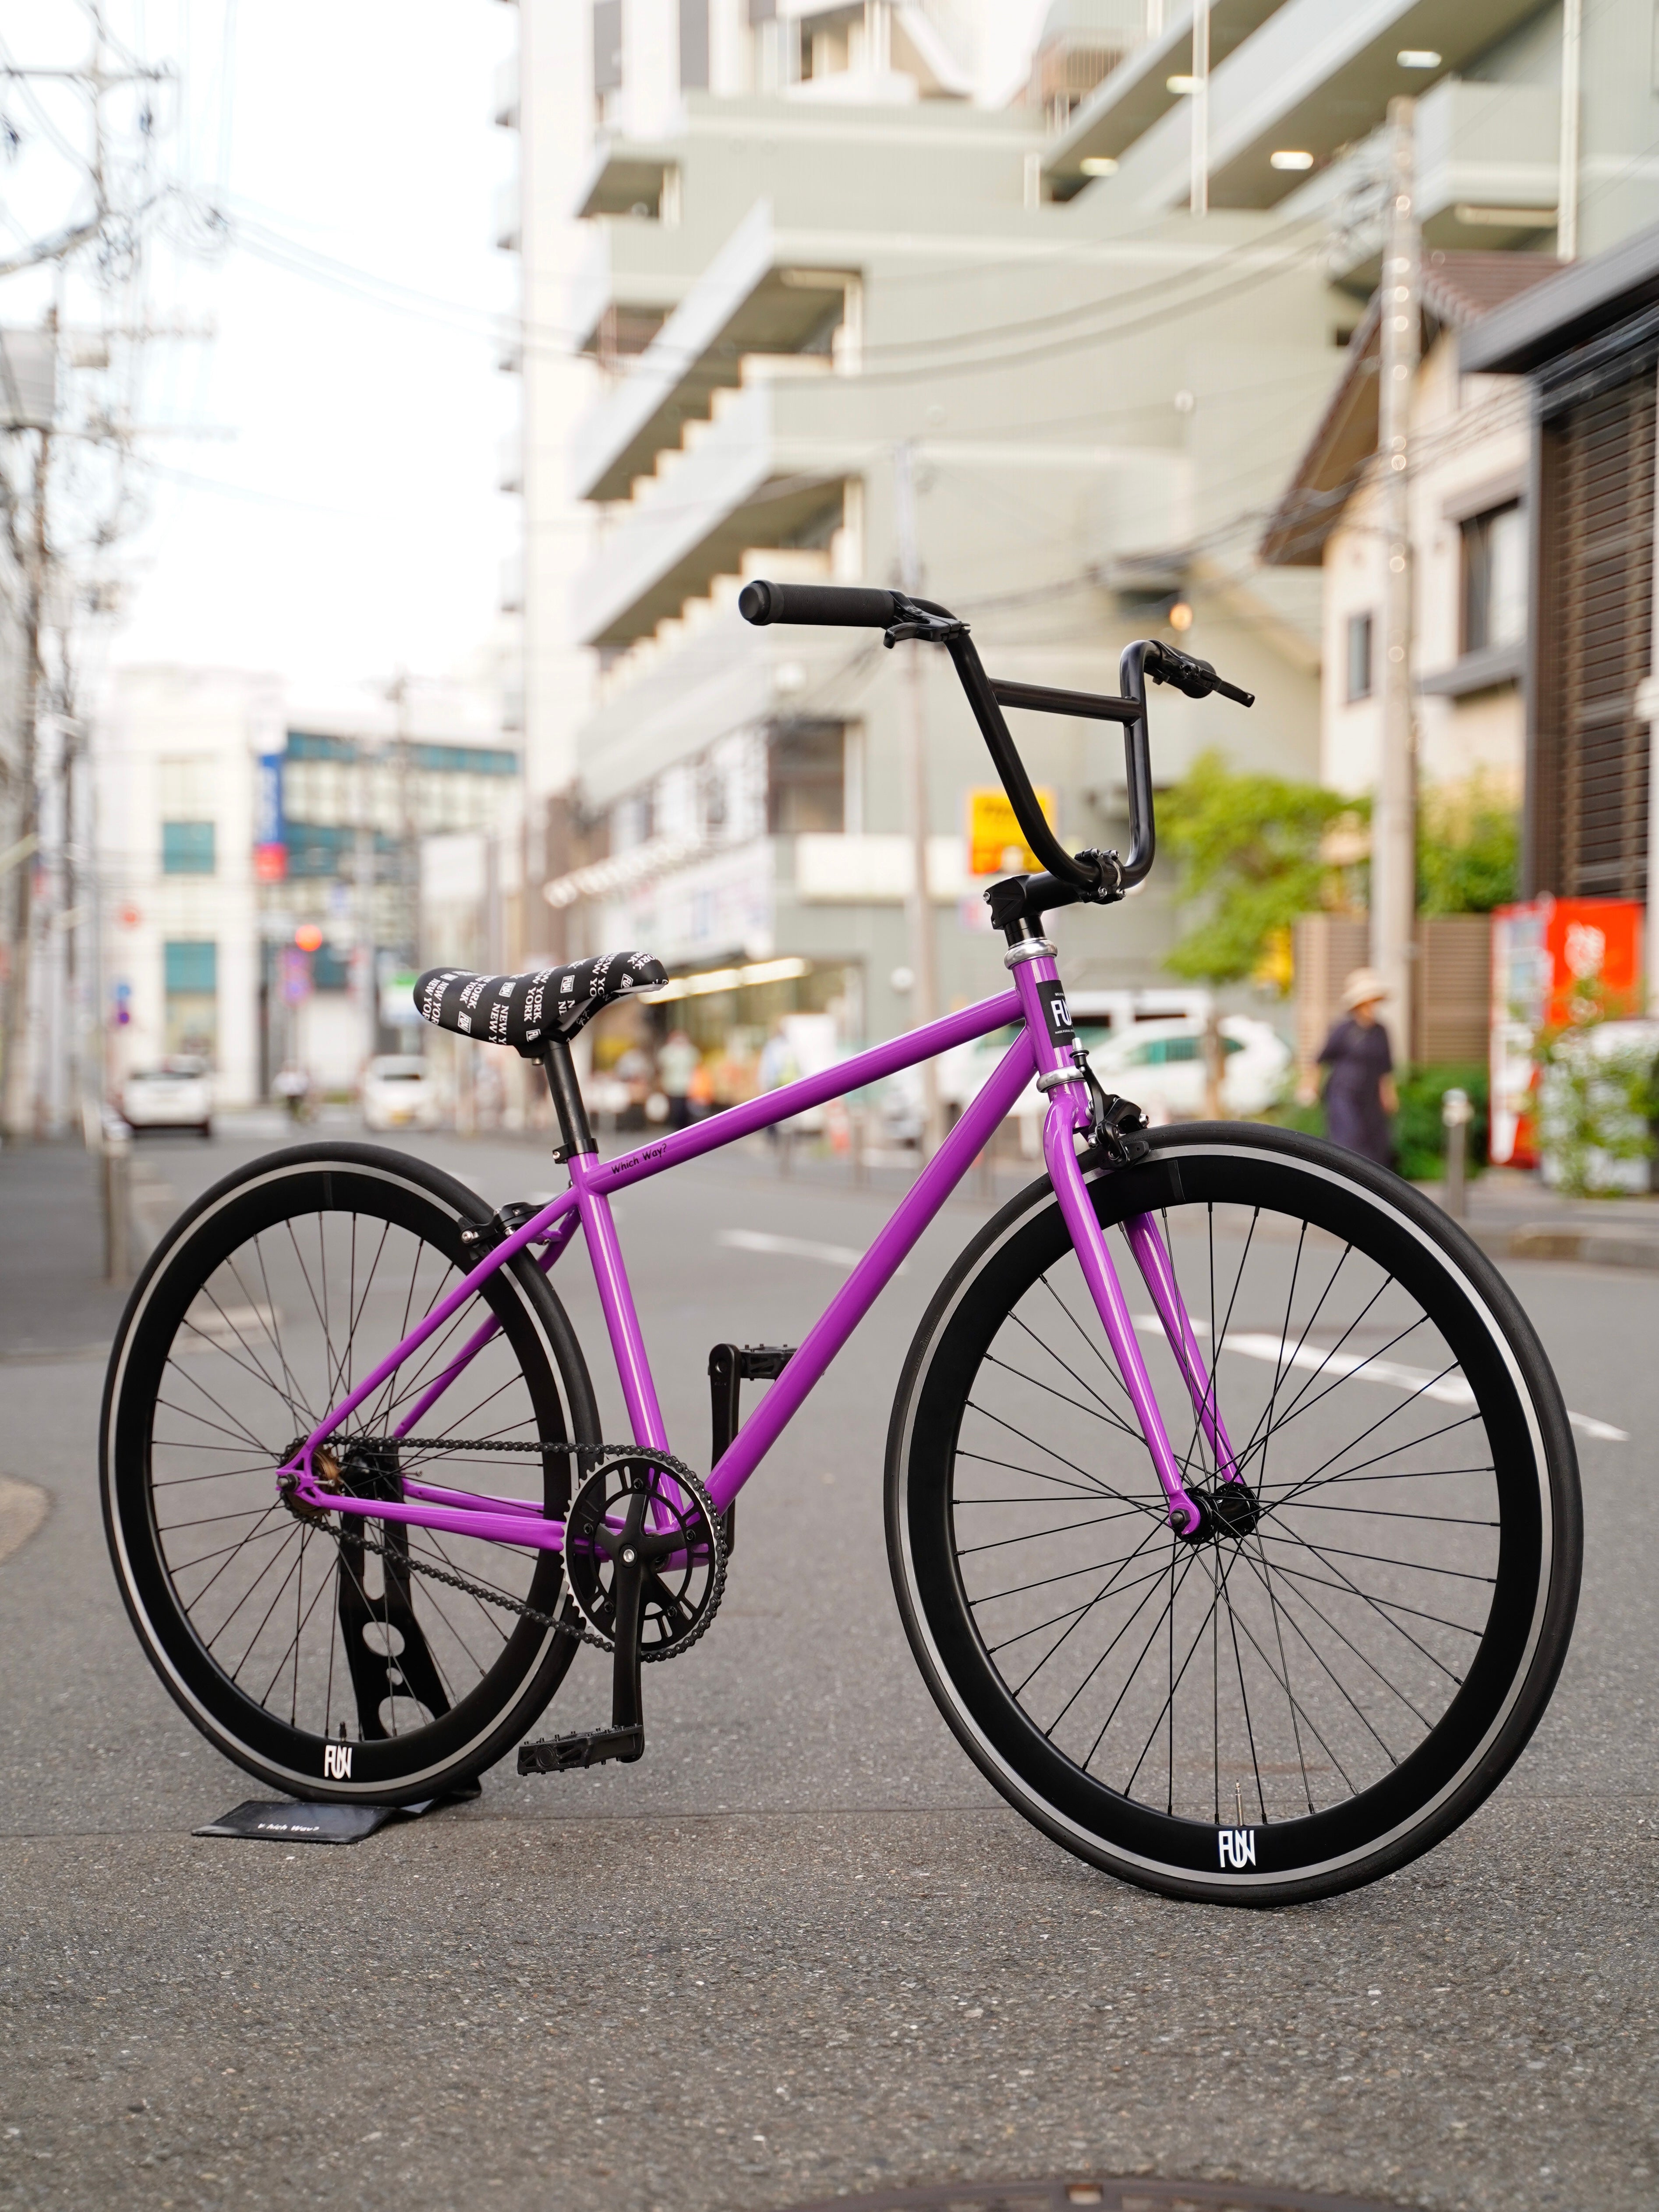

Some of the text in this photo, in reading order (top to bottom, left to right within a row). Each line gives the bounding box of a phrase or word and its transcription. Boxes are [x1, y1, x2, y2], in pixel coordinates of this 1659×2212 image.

[424, 978, 441, 996] NEW
[434, 981, 449, 1002] NEW
[489, 1002, 501, 1033] NEW
[524, 986, 537, 1022] YORK
[498, 1005, 509, 1035] NEW
[611, 1143, 667, 1175] Which Way?
[325, 1745, 352, 1779] FUN
[1218, 1830, 1256, 1868] FUN
